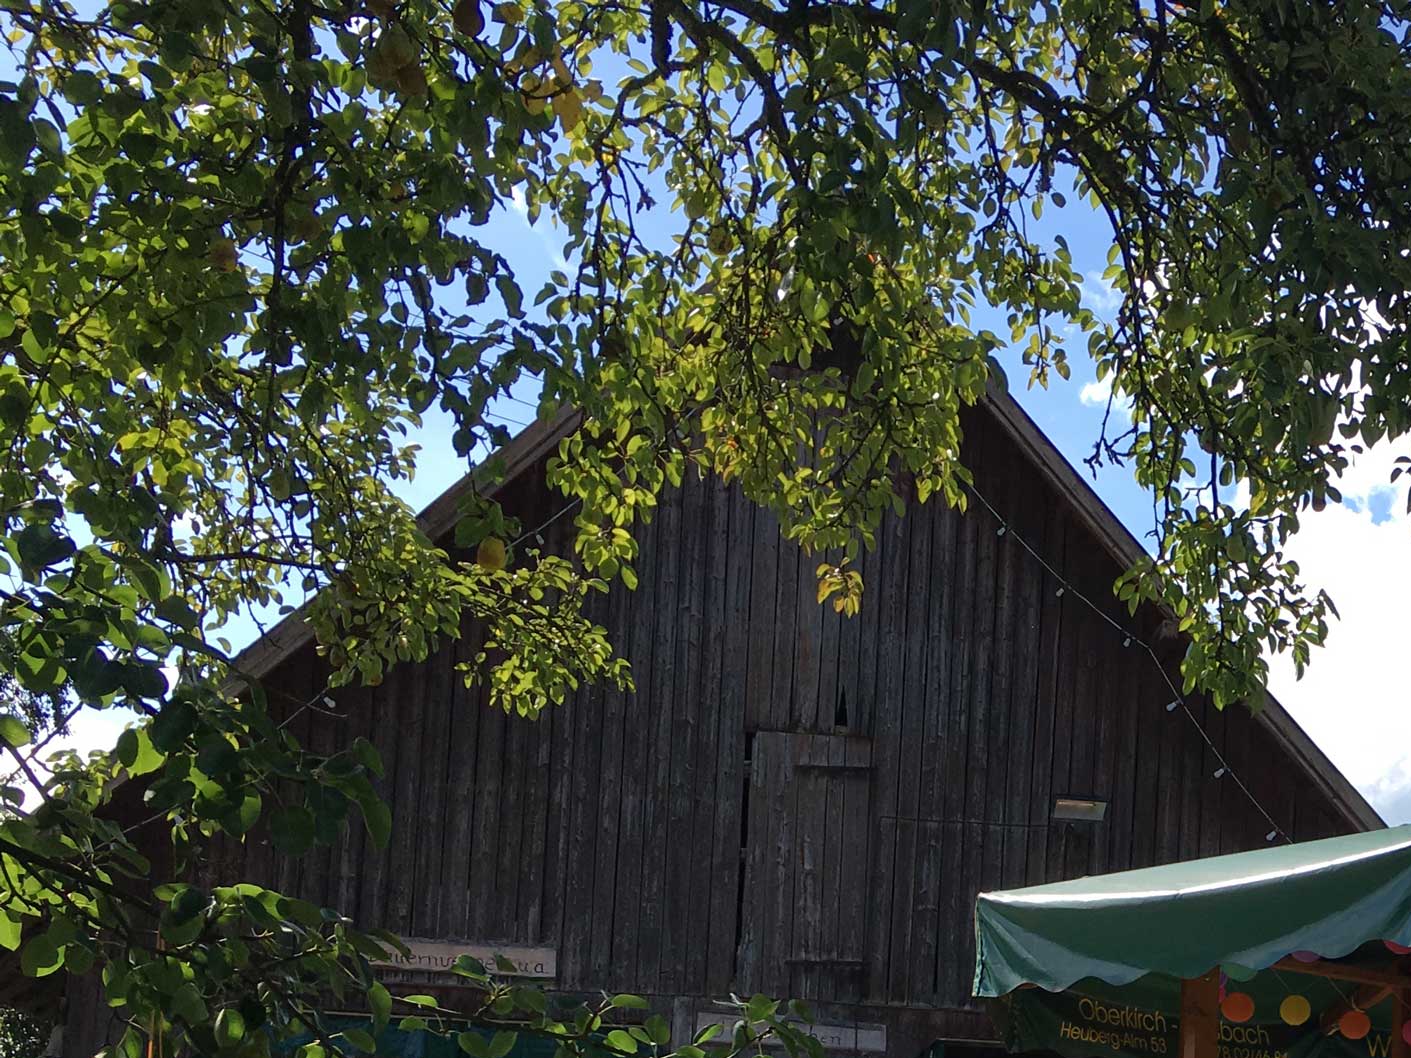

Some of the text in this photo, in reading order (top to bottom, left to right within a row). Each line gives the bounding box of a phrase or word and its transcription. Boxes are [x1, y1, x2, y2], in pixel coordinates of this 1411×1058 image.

[1060, 1021, 1147, 1050] Heuberg-Alm
[1150, 1037, 1168, 1054] 53
[1078, 998, 1167, 1032] Oberkirch
[1217, 1020, 1271, 1045] bach
